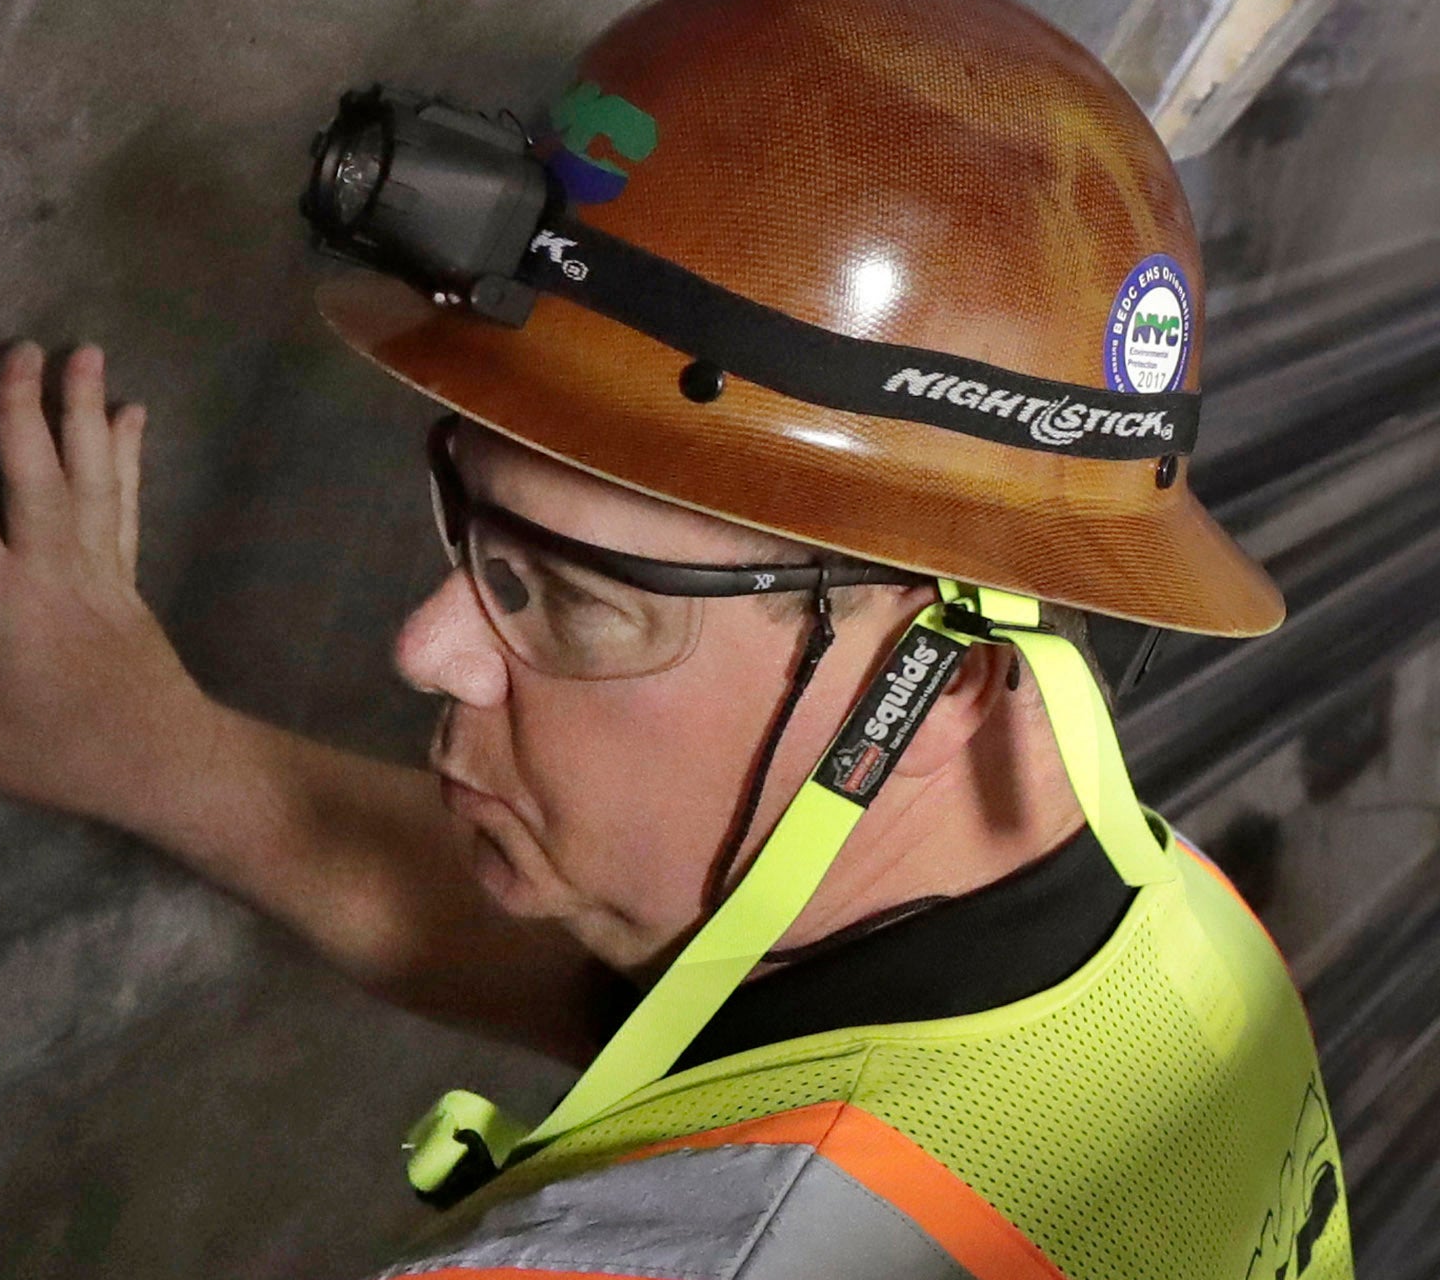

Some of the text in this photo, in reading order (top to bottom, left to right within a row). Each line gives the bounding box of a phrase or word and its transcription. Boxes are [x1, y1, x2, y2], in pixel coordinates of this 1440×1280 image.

[1113, 265, 1189, 341] BEDC EHS Orientation
[1131, 311, 1180, 347] NYC
[1137, 370, 1166, 389] 2017
[753, 573, 776, 590] XP
[864, 643, 938, 740] squids
